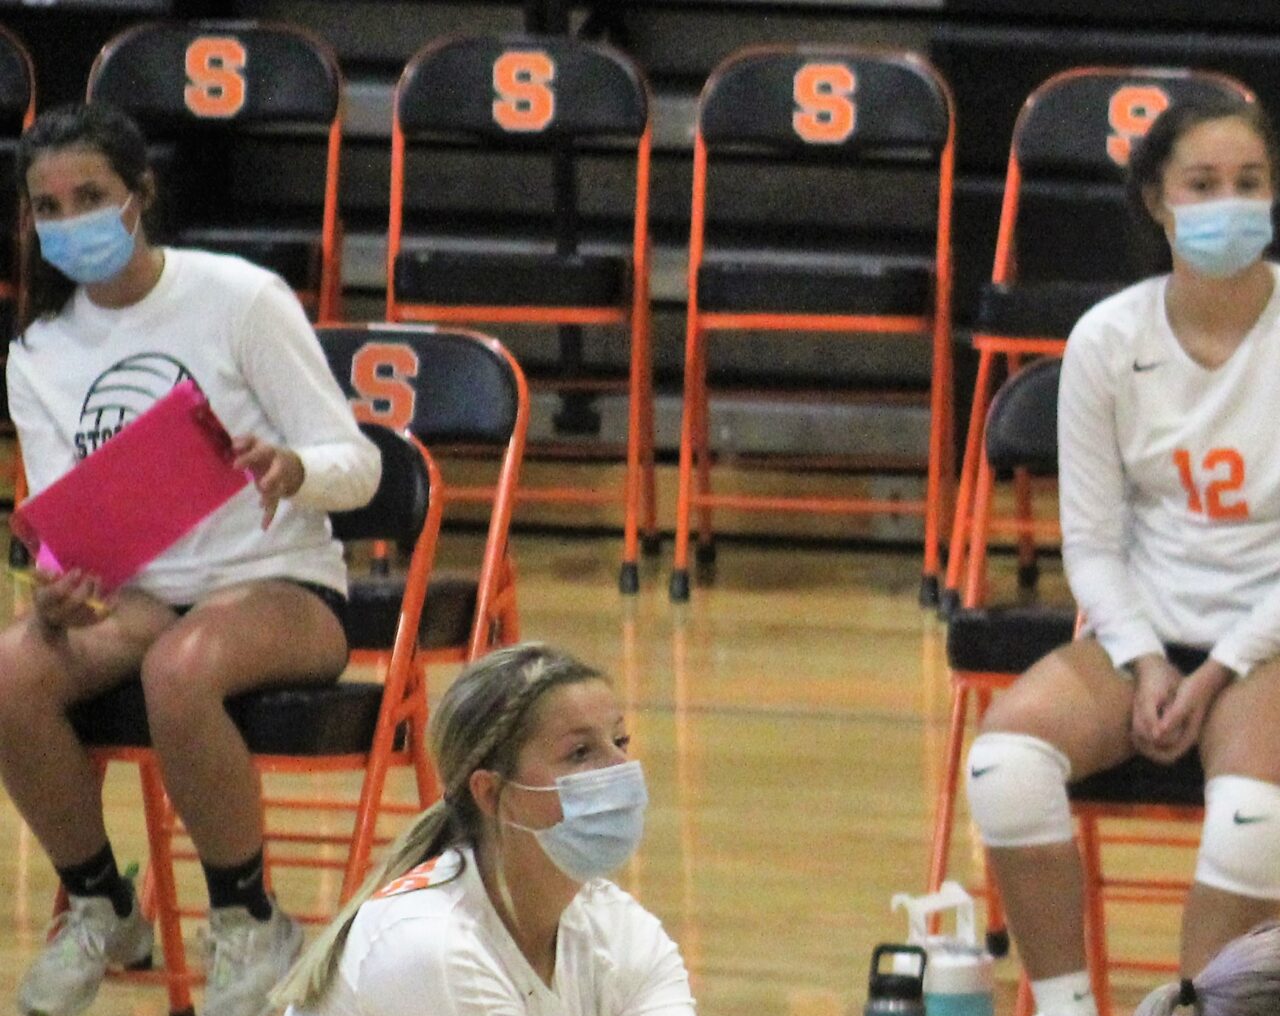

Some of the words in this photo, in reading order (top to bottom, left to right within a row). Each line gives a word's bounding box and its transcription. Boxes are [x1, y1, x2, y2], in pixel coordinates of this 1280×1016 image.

[185, 36, 247, 118] S
[492, 49, 555, 132] S
[793, 62, 856, 144] S
[350, 342, 418, 432] S
[1171, 446, 1250, 521] 12
